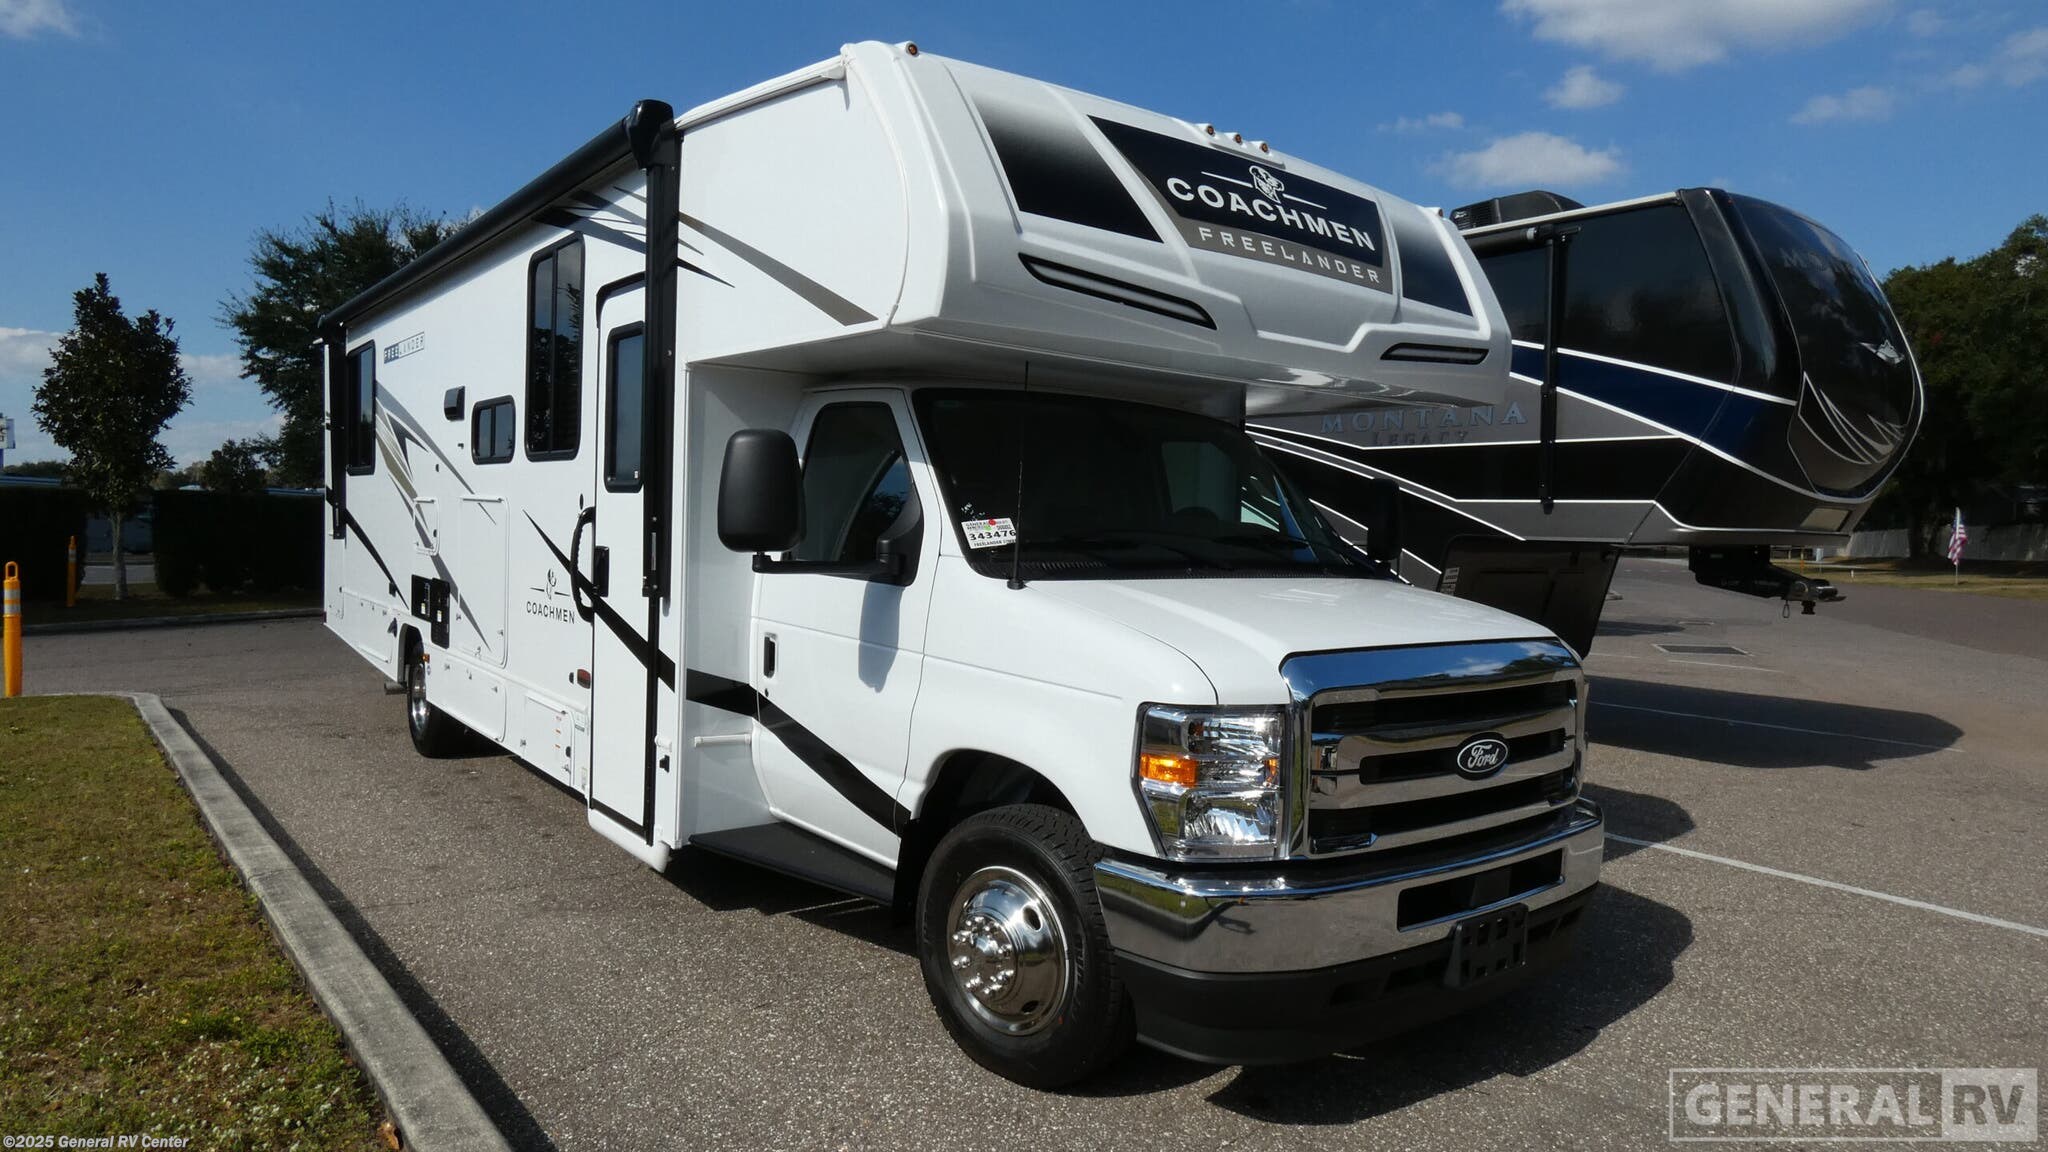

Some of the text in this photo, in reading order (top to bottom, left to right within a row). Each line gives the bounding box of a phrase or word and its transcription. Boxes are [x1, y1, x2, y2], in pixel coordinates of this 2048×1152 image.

[1166, 177, 1376, 252] COACHMEN
[1198, 226, 1380, 284] FREELANDER
[1320, 401, 1528, 434] MONTANA
[969, 530, 1016, 540] 343476
[526, 601, 575, 624] COACHMEN
[1467, 744, 1499, 769] Ford
